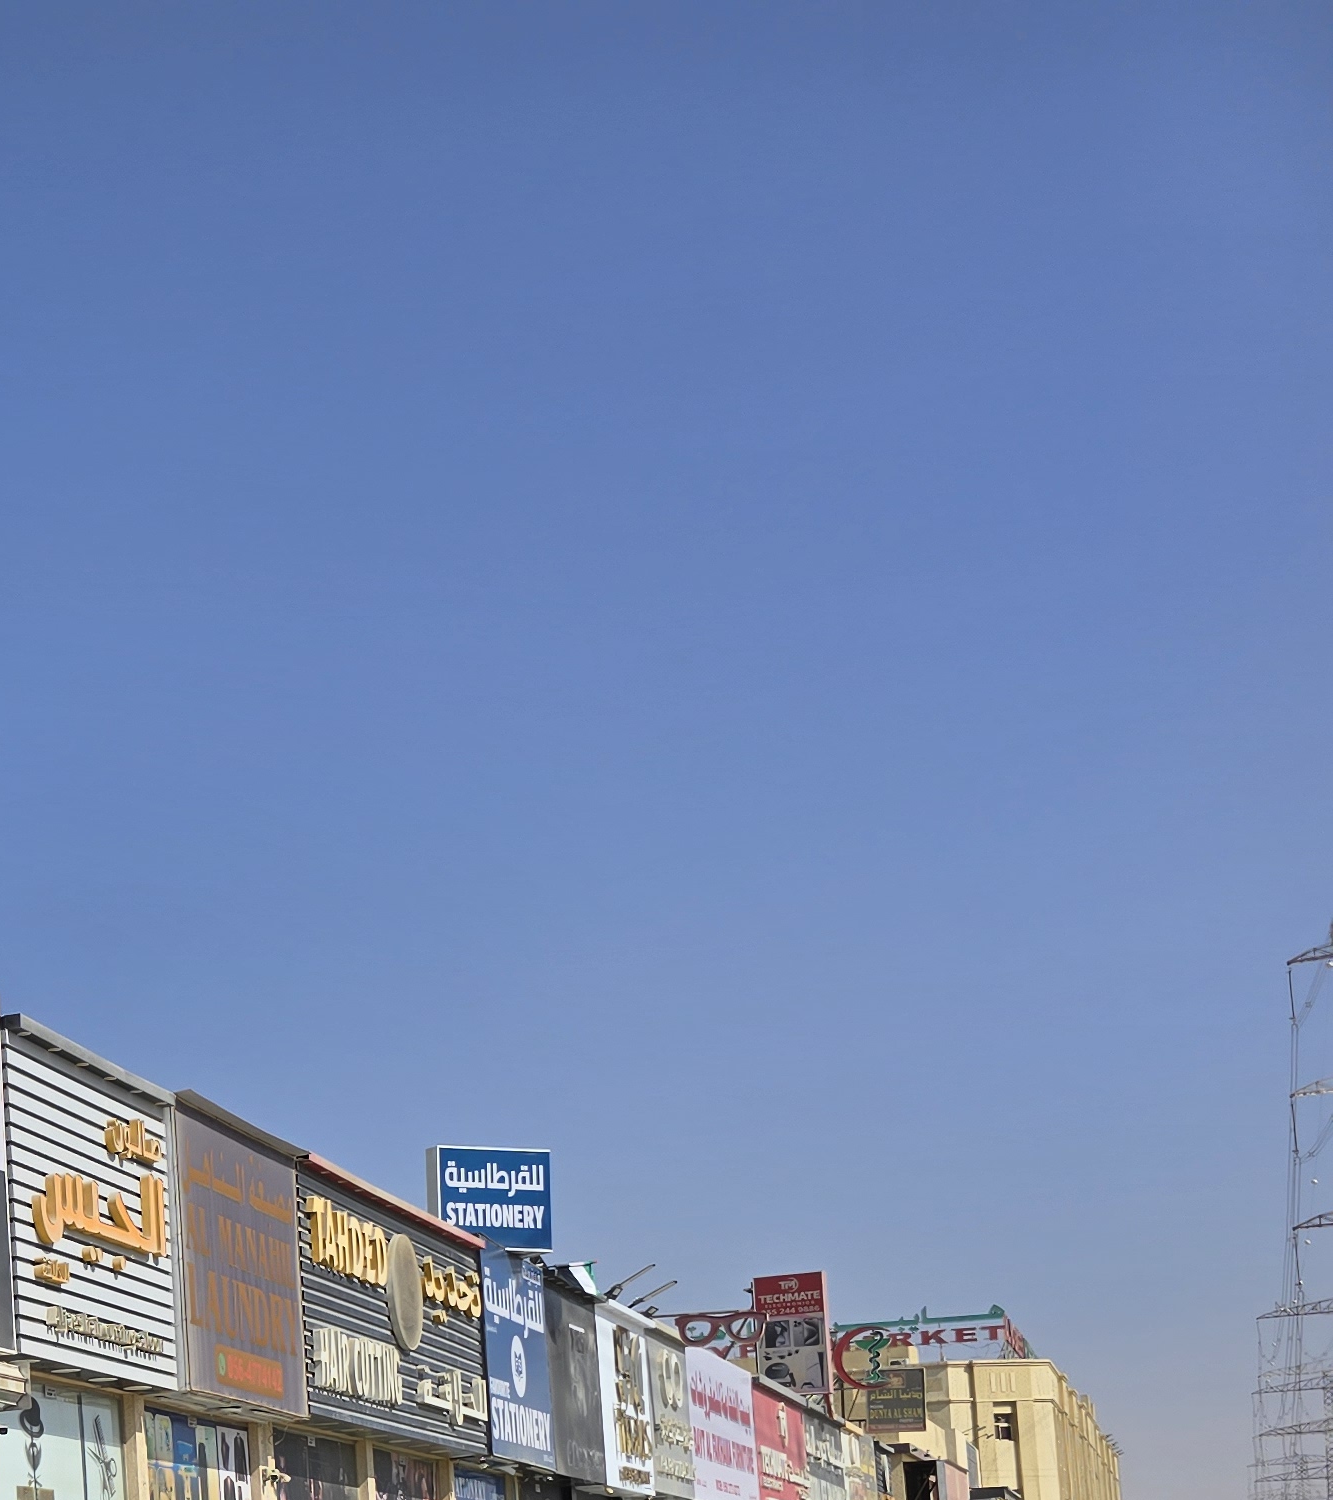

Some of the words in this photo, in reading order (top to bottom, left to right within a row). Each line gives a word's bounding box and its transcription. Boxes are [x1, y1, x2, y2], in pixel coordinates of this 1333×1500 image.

[445, 1160, 545, 1197] للقرطاسية
[186, 1203, 211, 1258] AL
[446, 1202, 545, 1230] STATIONERY
[187, 1260, 298, 1357] LAUNDRY
[757, 1290, 821, 1304] TECHMATE
[312, 1327, 350, 1395] HAIR
[349, 1336, 403, 1406] CUTTING
[491, 1396, 552, 1453] STATIONERY
